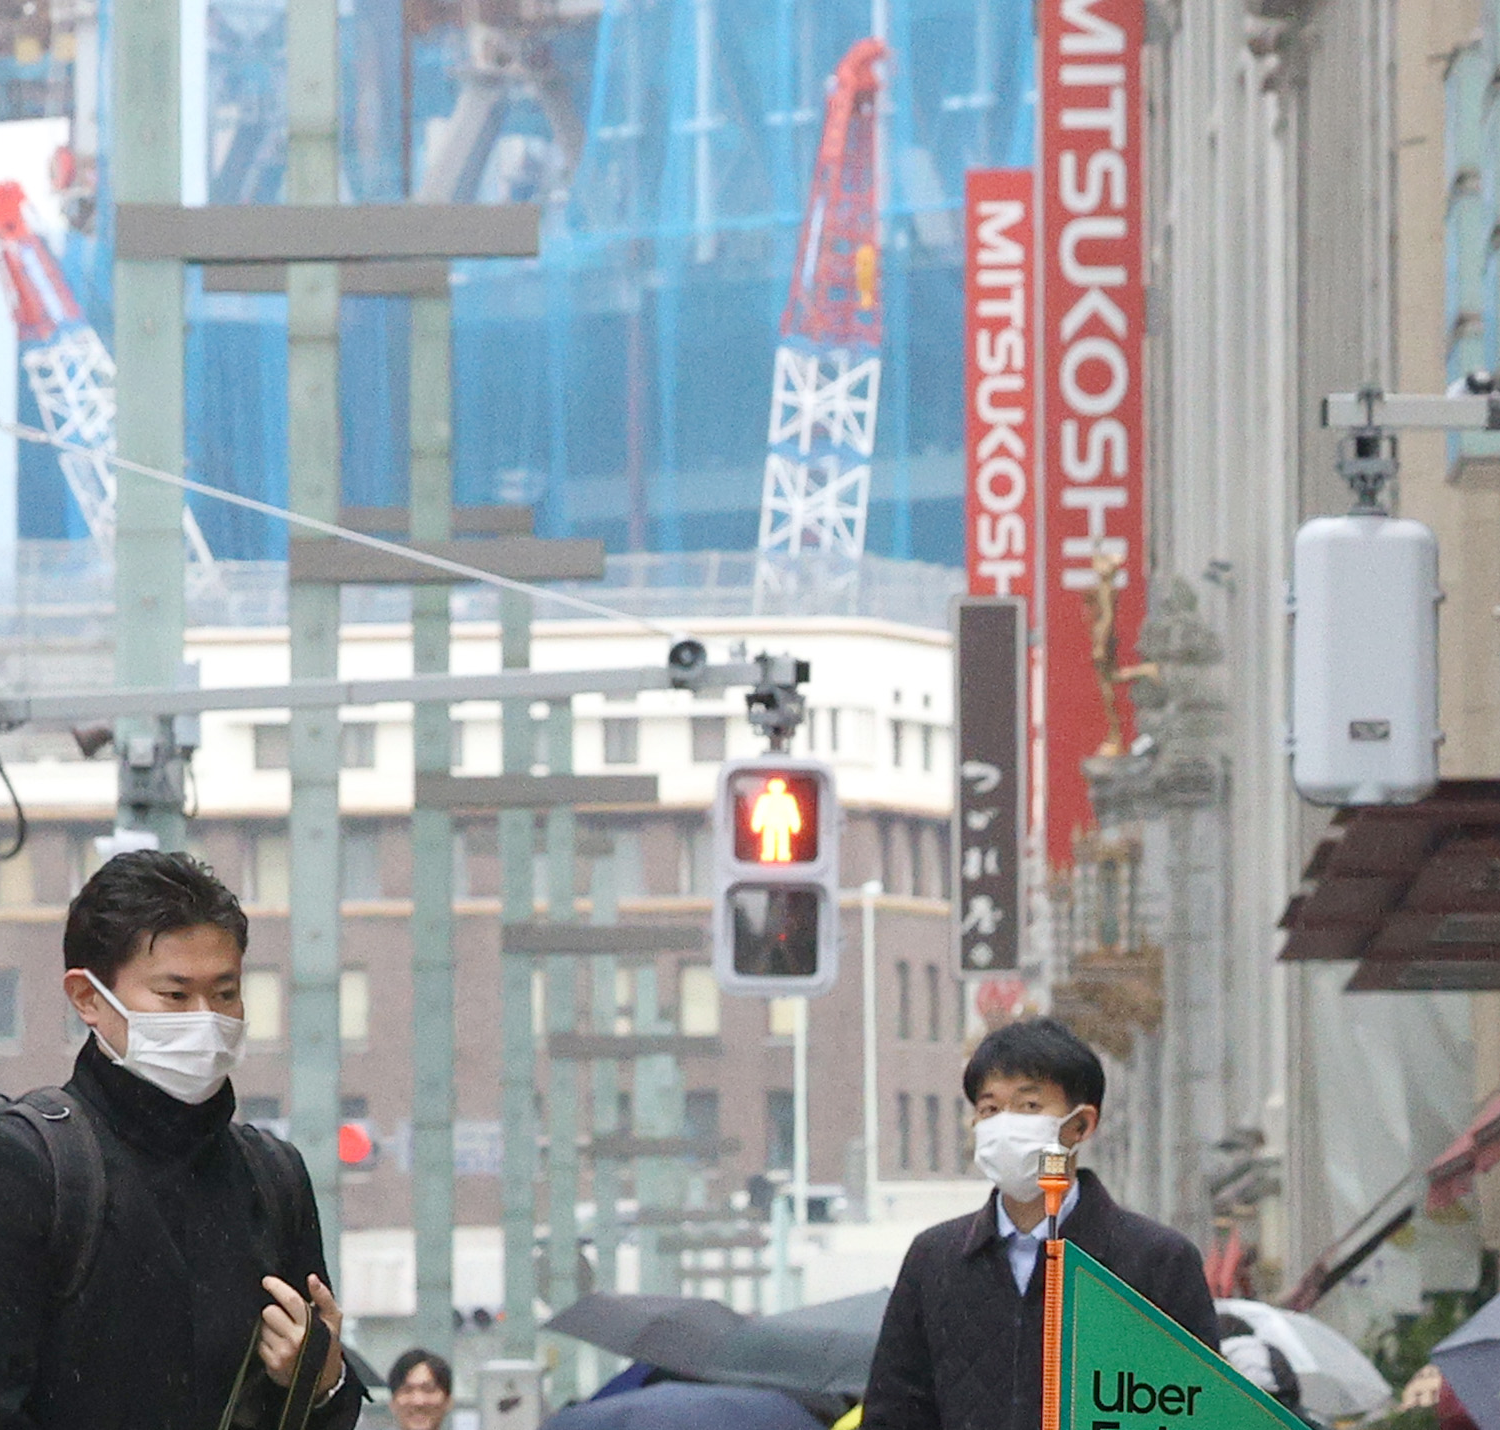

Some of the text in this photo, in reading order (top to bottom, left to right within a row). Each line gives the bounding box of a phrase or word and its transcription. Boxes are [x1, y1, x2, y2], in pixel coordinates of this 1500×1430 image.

[976, 199, 1026, 599] MITSUKOSH
[1059, 0, 1129, 590] MITSUKOSHI
[1091, 1370, 1203, 1416] Uber
